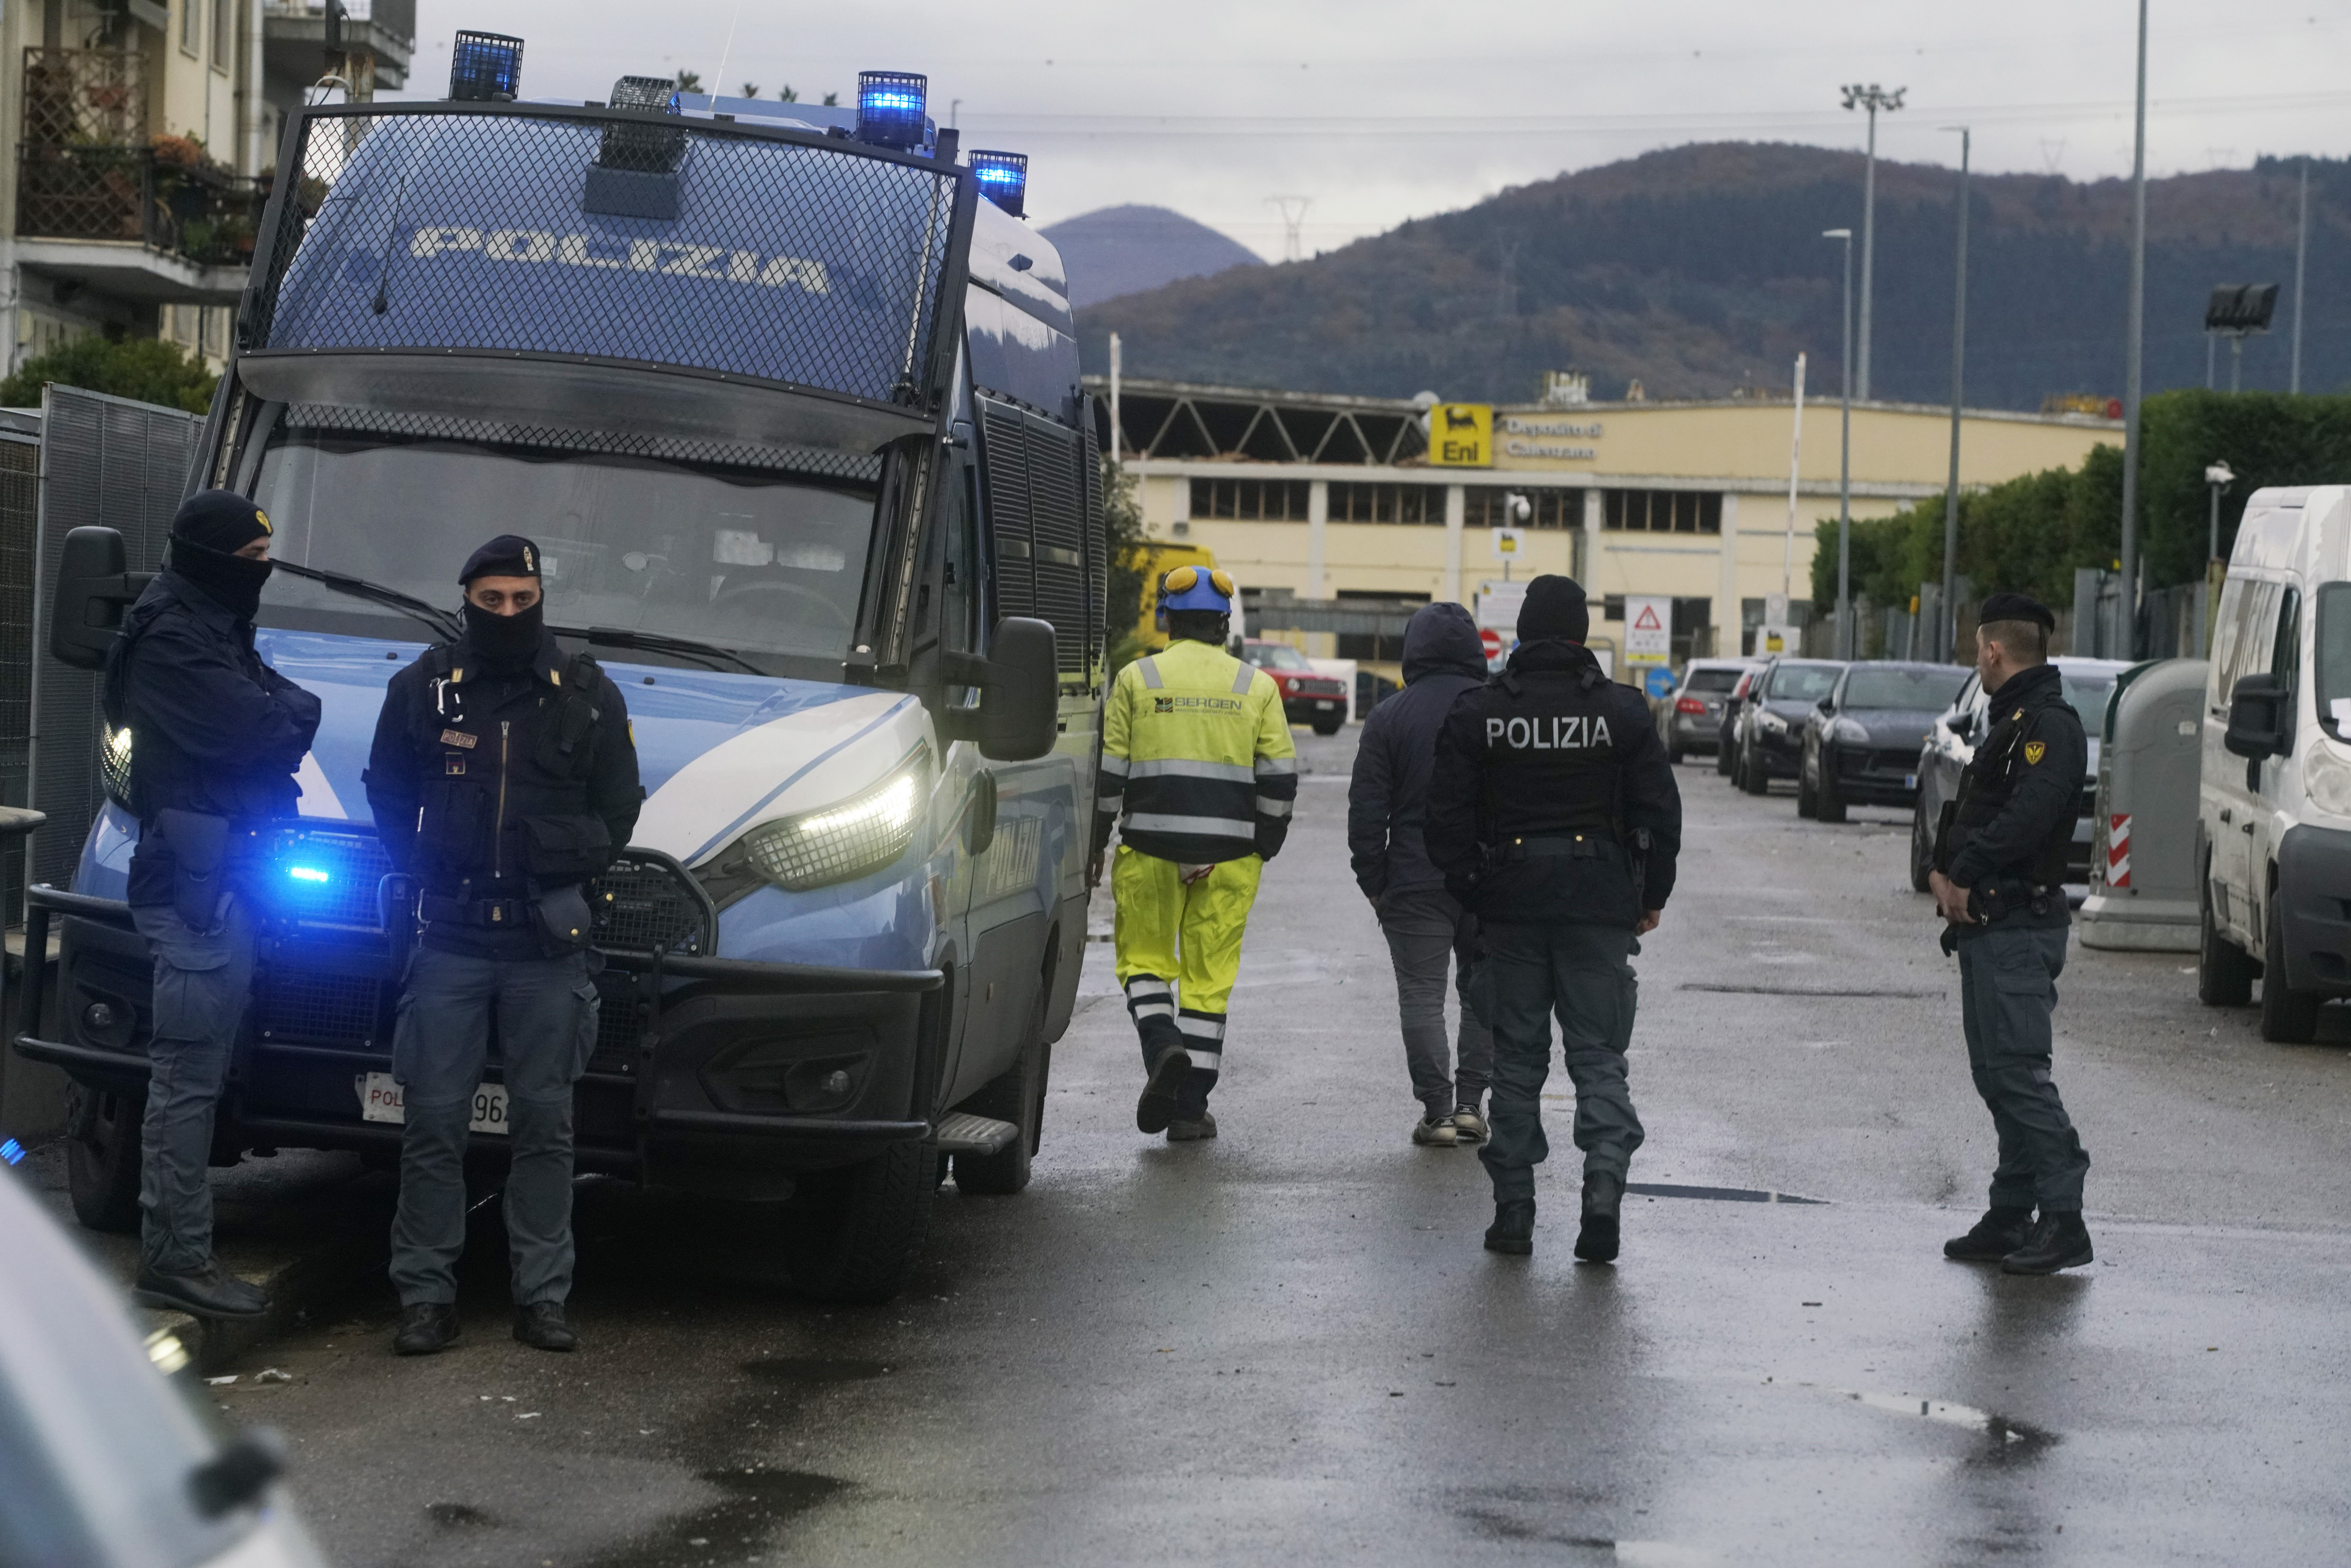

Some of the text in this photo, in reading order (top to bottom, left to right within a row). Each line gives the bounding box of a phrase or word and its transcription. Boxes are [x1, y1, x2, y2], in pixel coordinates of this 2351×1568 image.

[411, 227, 830, 294] POLIZIA
[1174, 697, 1242, 710] SERGEN
[1486, 715, 1613, 750] POLIZIA
